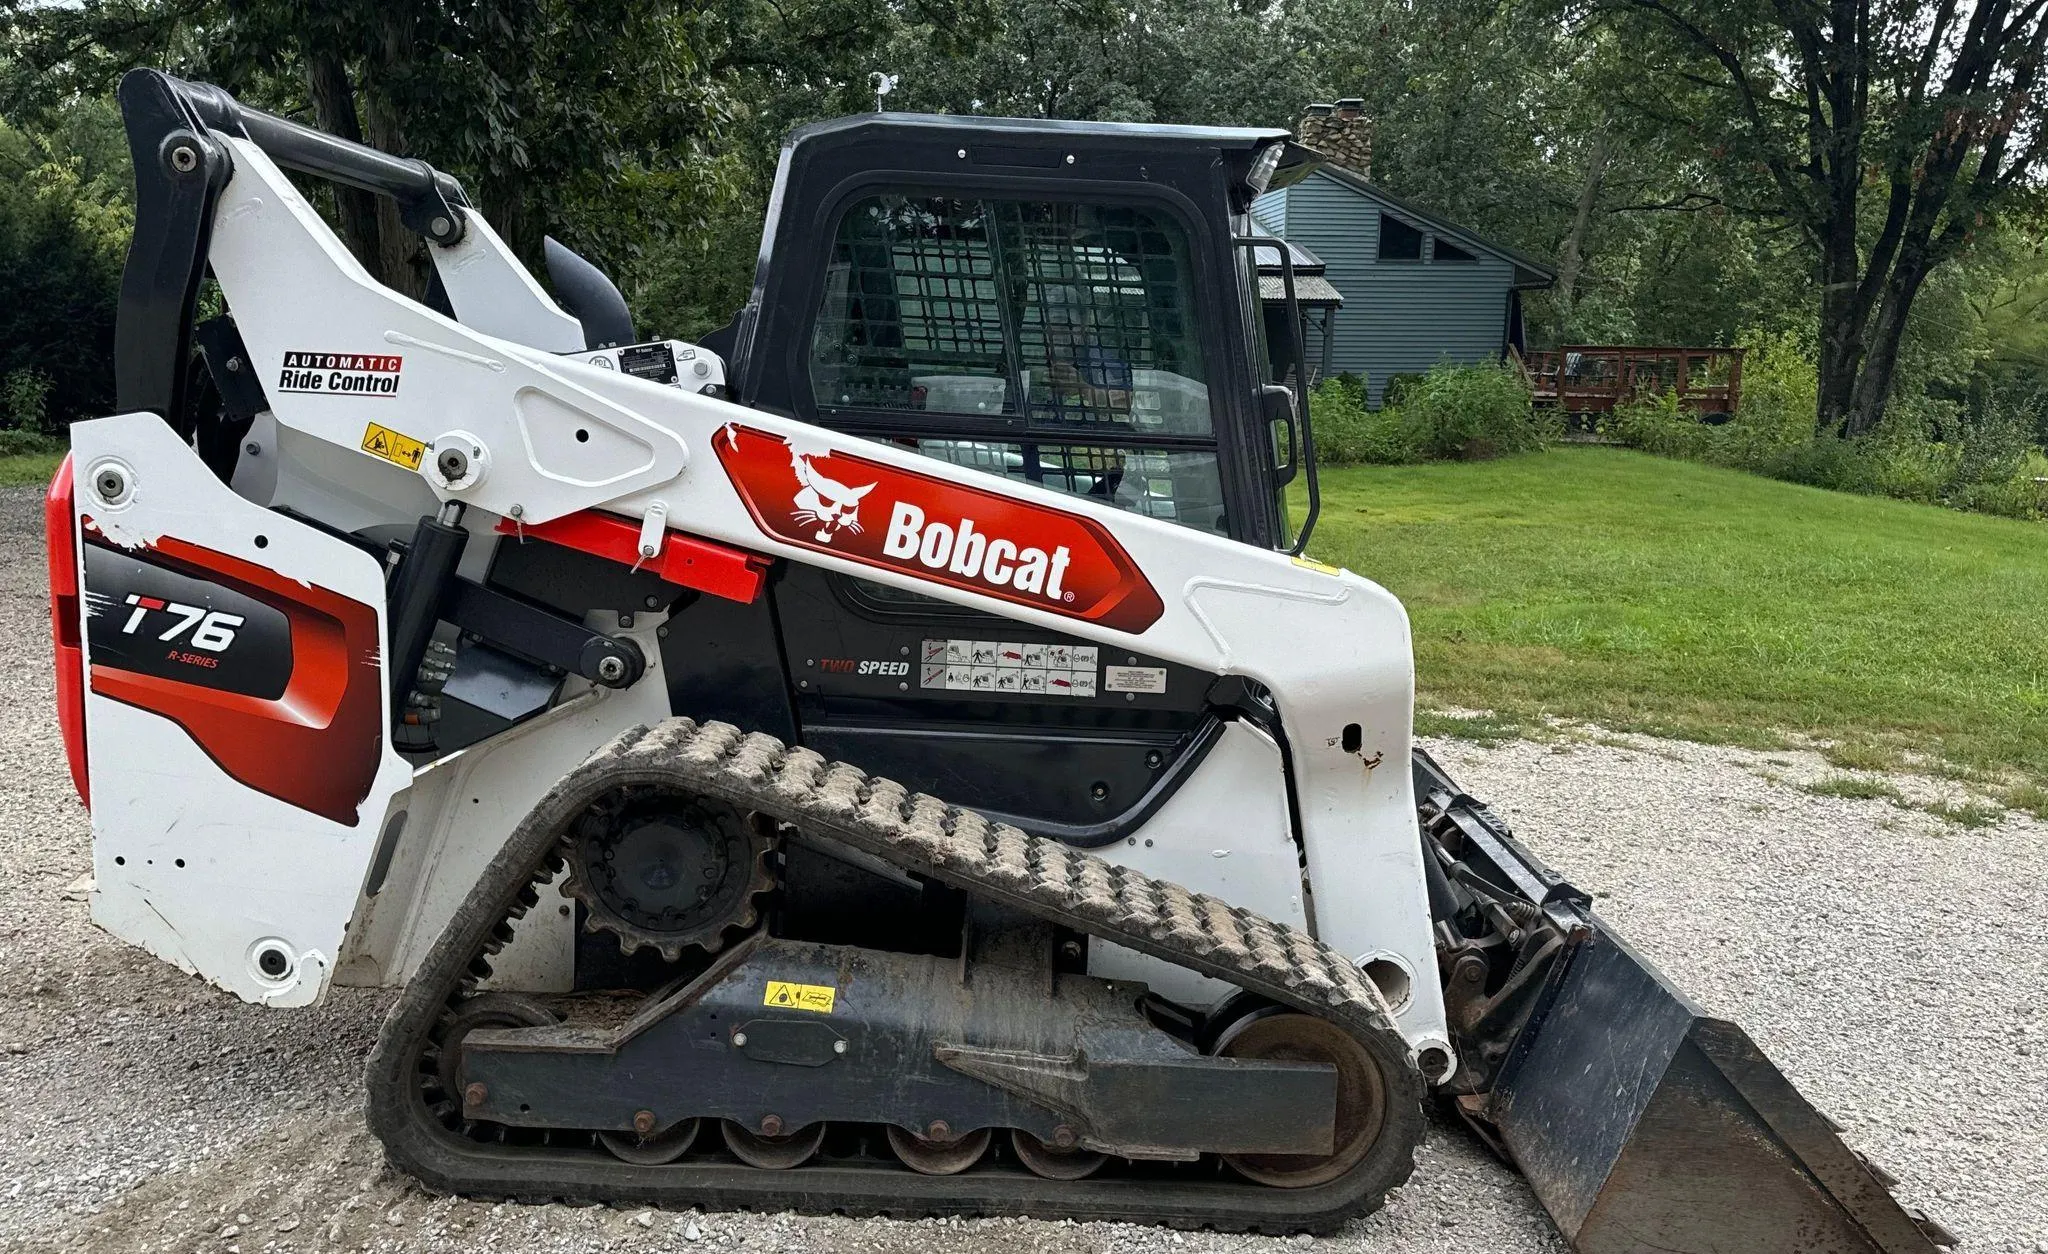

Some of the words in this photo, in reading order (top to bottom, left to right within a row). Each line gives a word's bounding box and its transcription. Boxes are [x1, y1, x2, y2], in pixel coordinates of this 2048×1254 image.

[288, 354, 397, 370] AUTOMATIC
[594, 359, 607, 367] PDI
[279, 370, 323, 390] Ride
[328, 372, 400, 393] Control
[122, 594, 244, 652] T76
[167, 650, 219, 669] R-SERIES
[820, 659, 855, 673] TWO
[857, 660, 910, 676] SPEED
